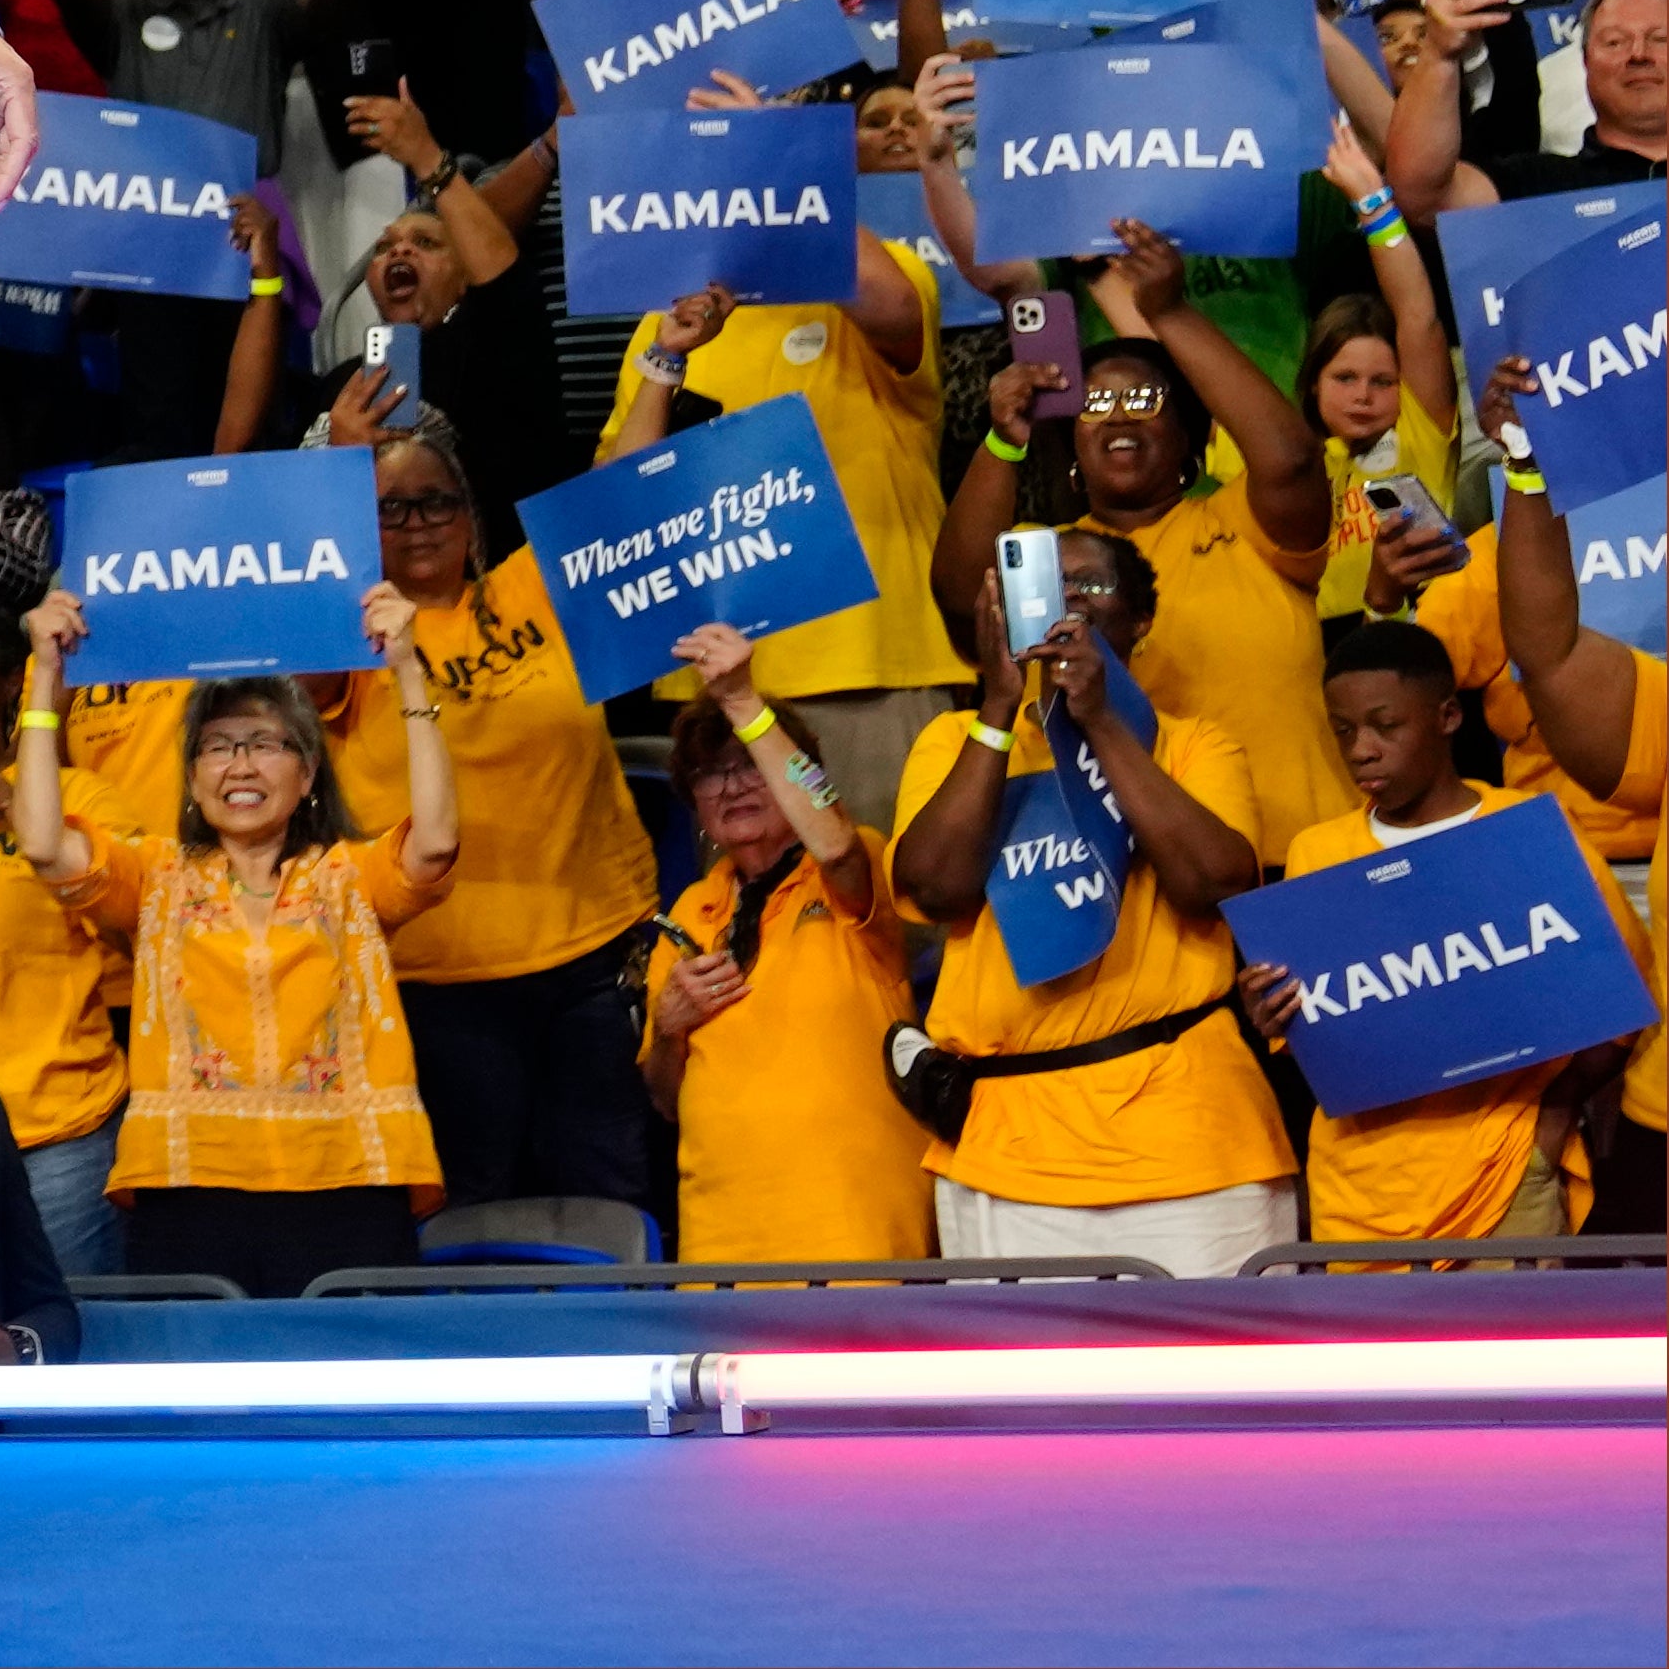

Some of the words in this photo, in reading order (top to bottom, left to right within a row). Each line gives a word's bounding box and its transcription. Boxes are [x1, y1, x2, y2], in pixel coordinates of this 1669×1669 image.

[1003, 127, 1265, 180] KAMALA
[589, 186, 831, 235] KAMALA
[1538, 308, 1667, 408] KAM
[560, 528, 656, 590] When
[659, 509, 704, 541] we
[706, 466, 816, 538] fight,
[85, 538, 350, 597] KAMALA
[607, 570, 679, 618] WE
[680, 529, 792, 587] WIN.
[1054, 871, 1105, 909] W
[1299, 902, 1581, 1024] KAMALA
